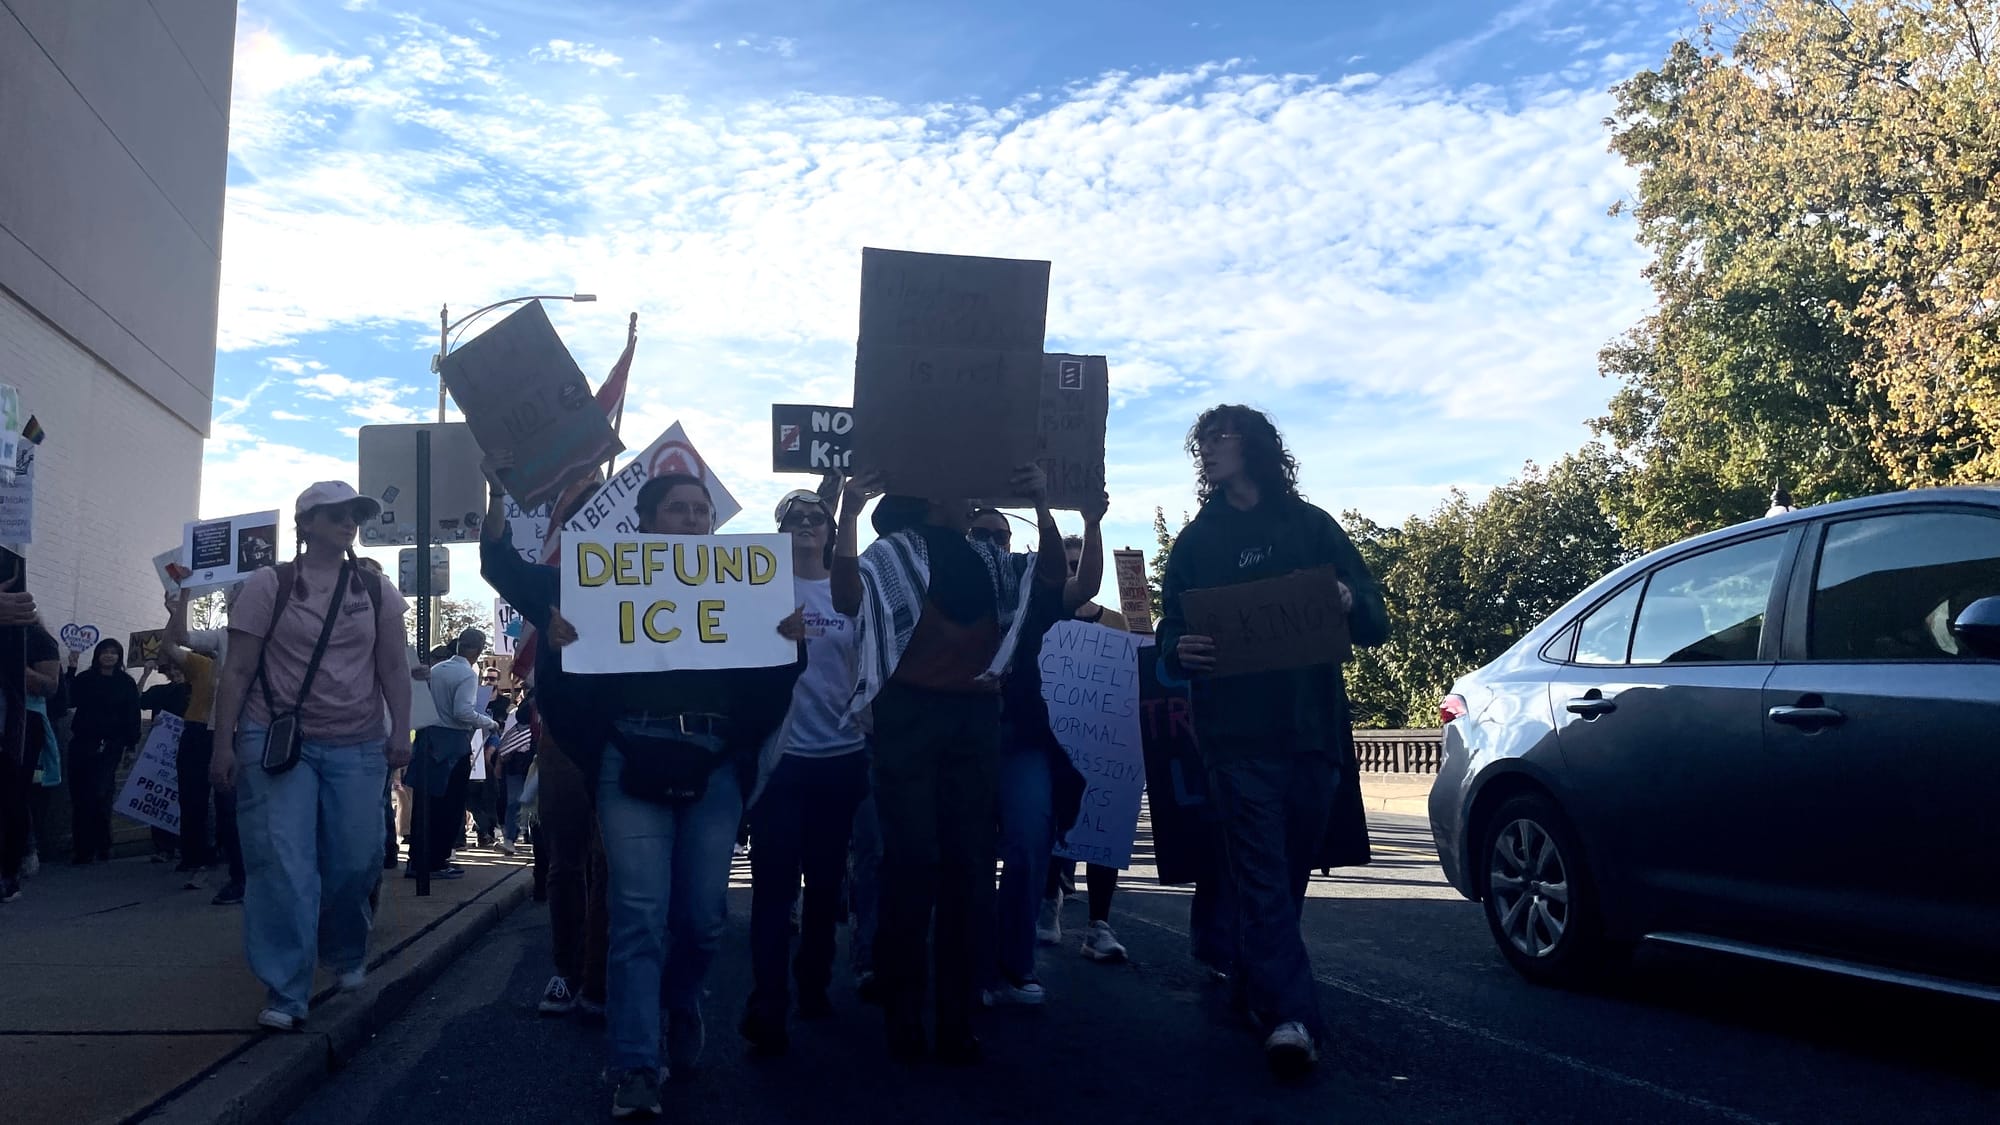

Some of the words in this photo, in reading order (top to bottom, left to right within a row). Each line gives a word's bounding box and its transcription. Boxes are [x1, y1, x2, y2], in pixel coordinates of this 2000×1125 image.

[811, 411, 854, 435] NO
[583, 461, 647, 529] BETTER
[577, 542, 777, 587] DEFUND
[619, 600, 728, 643] ICE
[1041, 653, 1138, 688] CRUELT
[1041, 681, 1138, 718] ECOMES
[136, 776, 179, 801] PROTE
[144, 793, 169, 811] OUR
